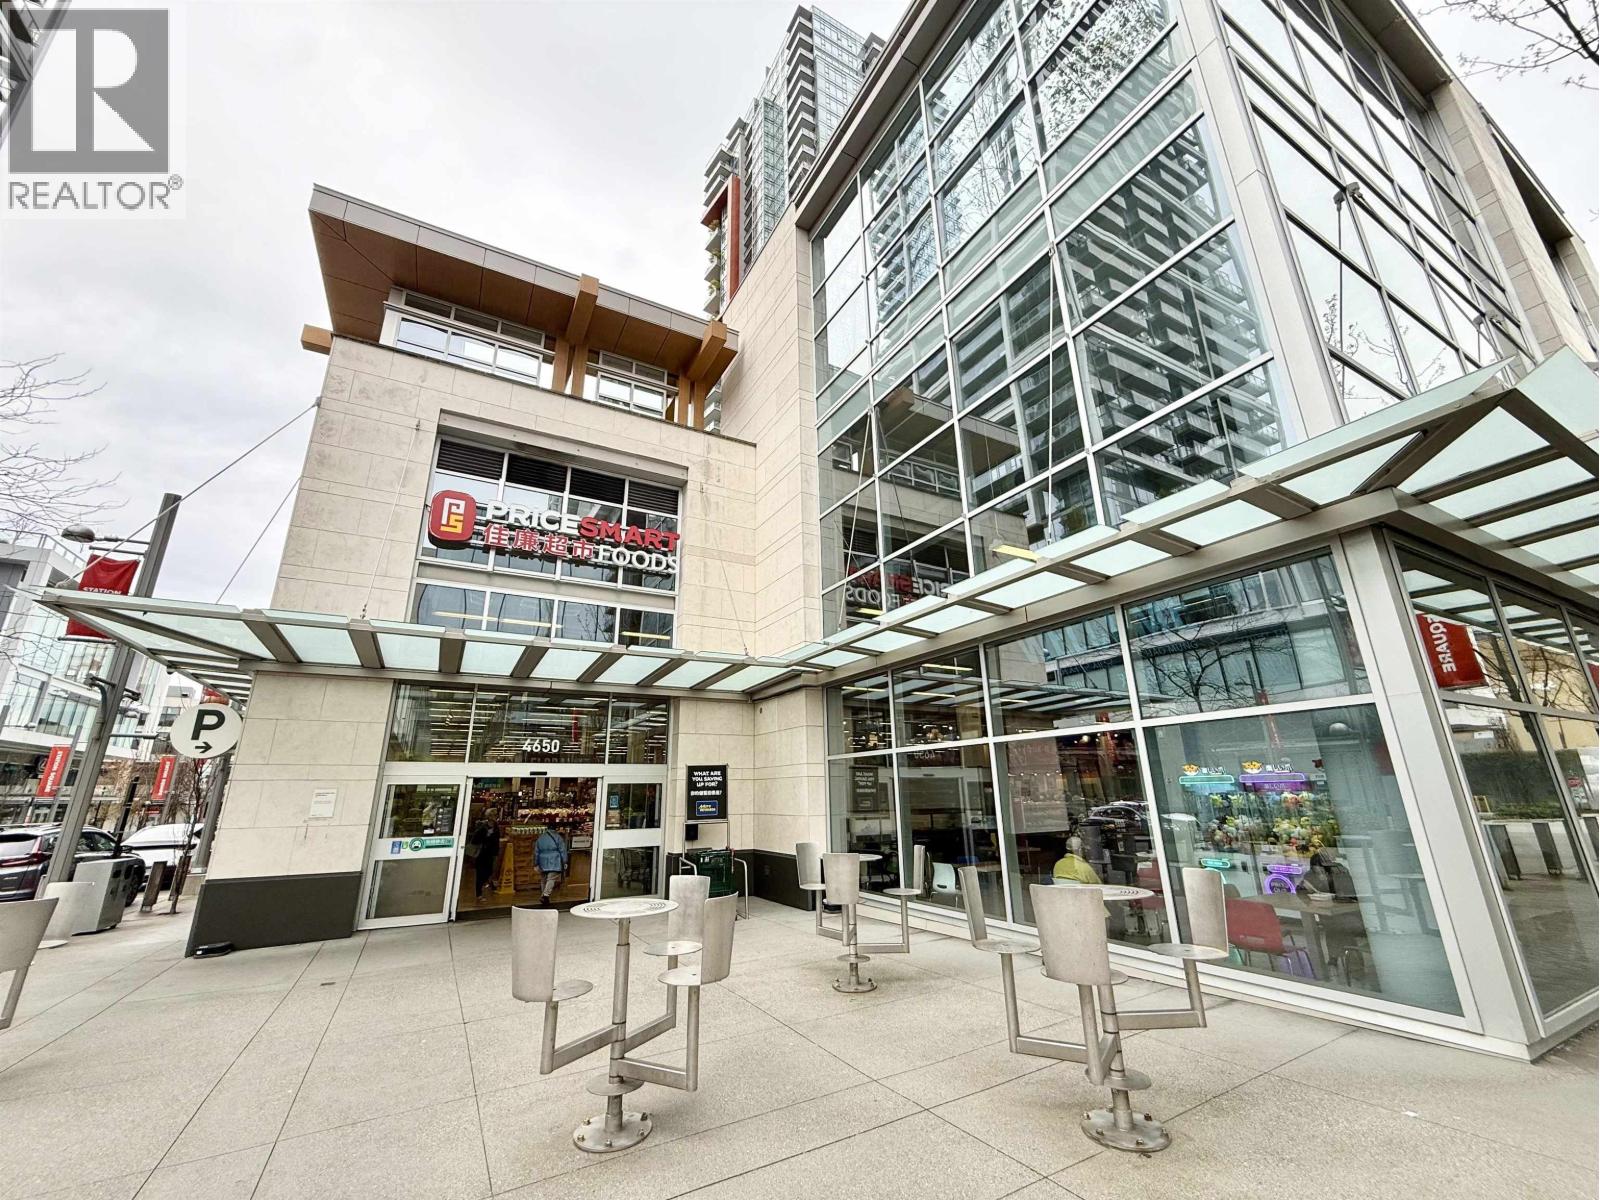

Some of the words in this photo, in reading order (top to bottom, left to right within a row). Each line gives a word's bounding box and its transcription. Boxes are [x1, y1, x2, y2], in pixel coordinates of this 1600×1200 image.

[597, 544, 677, 574] FOODS
[191, 709, 226, 740] P
[522, 738, 560, 753] 4650
